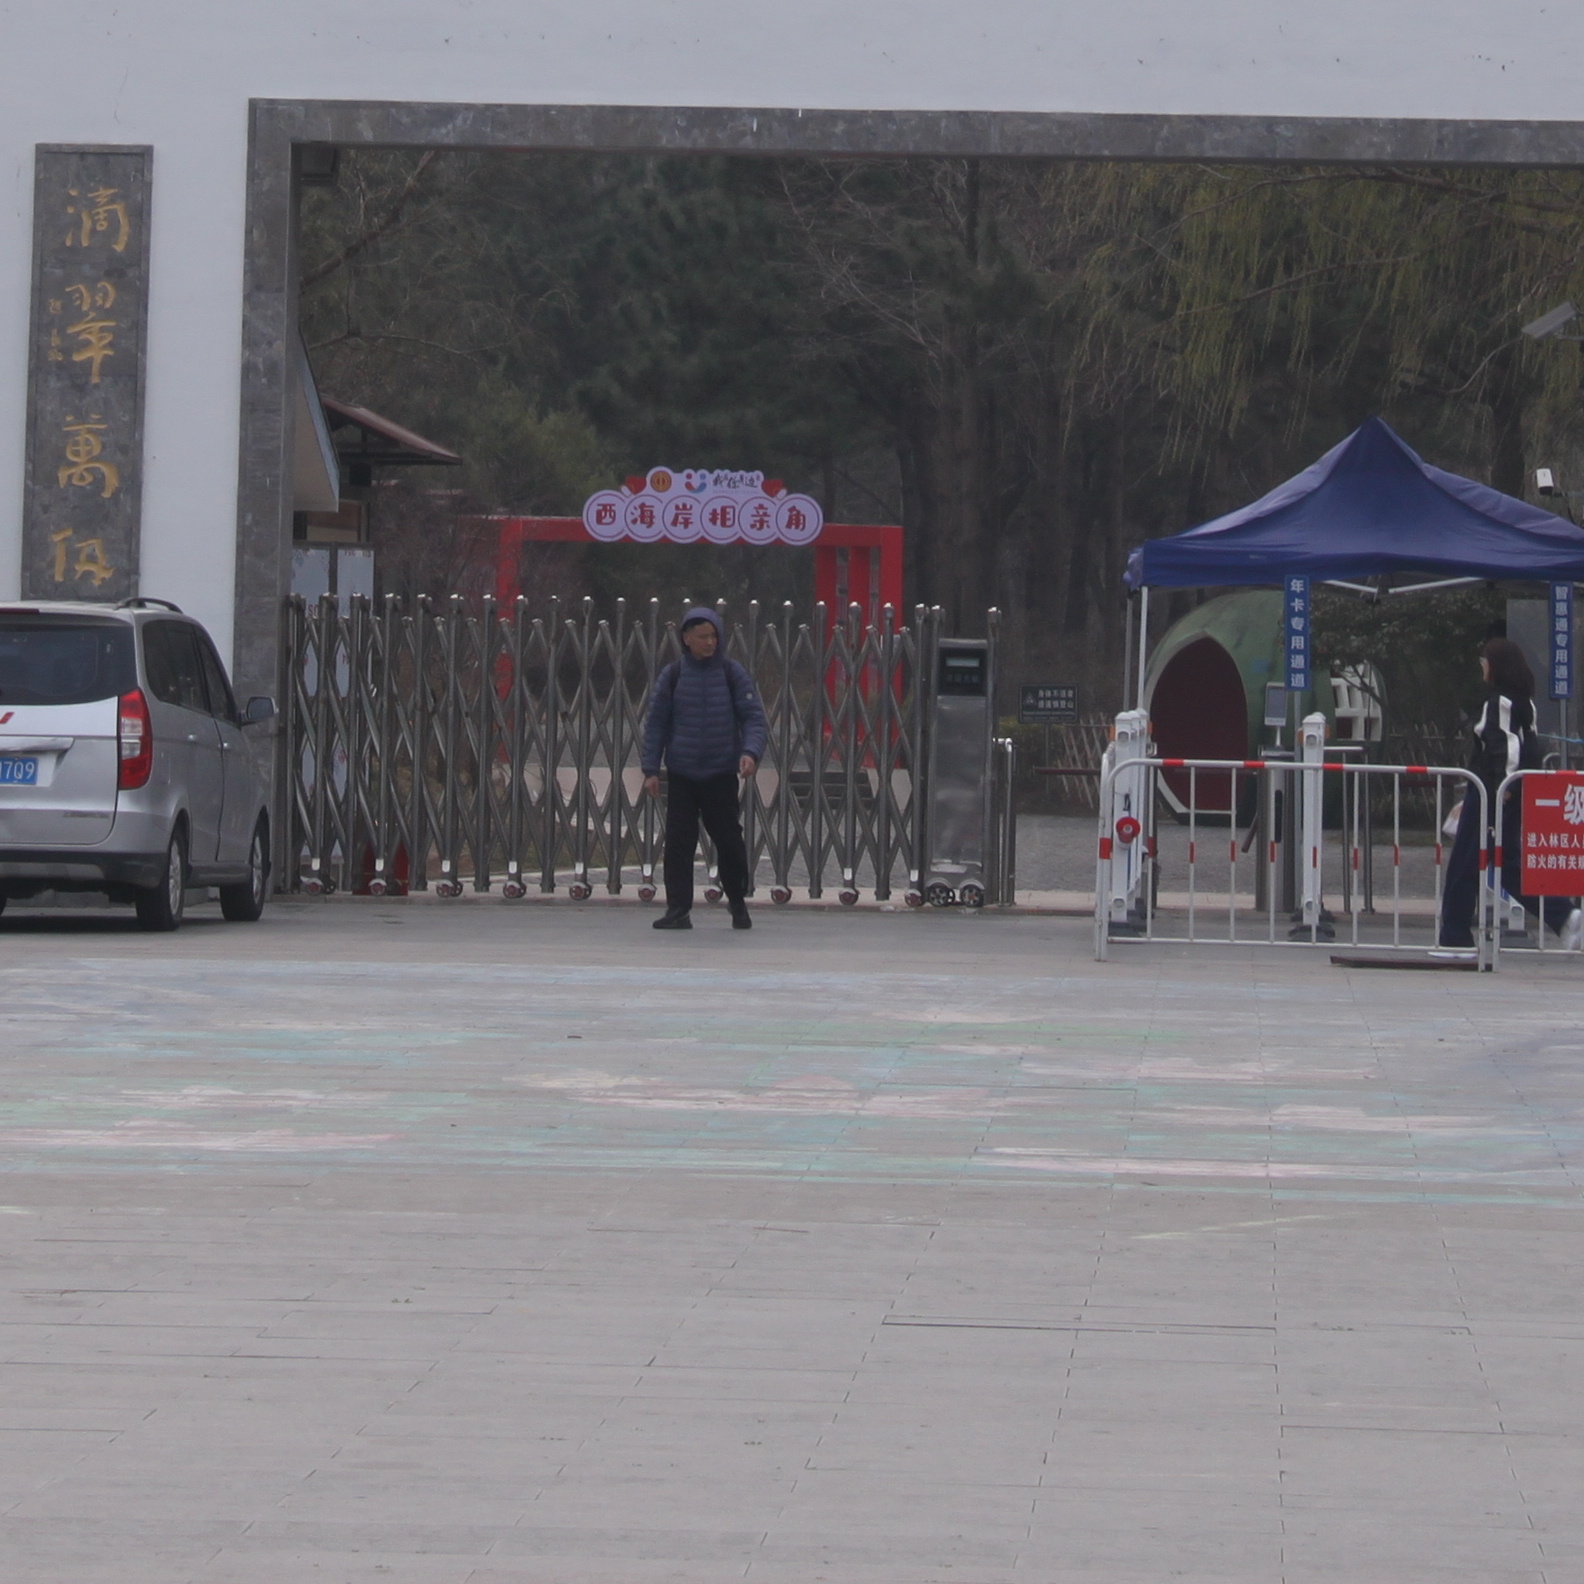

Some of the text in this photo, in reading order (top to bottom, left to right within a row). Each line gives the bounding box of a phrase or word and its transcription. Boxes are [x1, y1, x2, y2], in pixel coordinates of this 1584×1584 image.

[594, 502, 808, 534] 西海岸相亲角
[1289, 578, 1305, 688] 年卡专用通道
